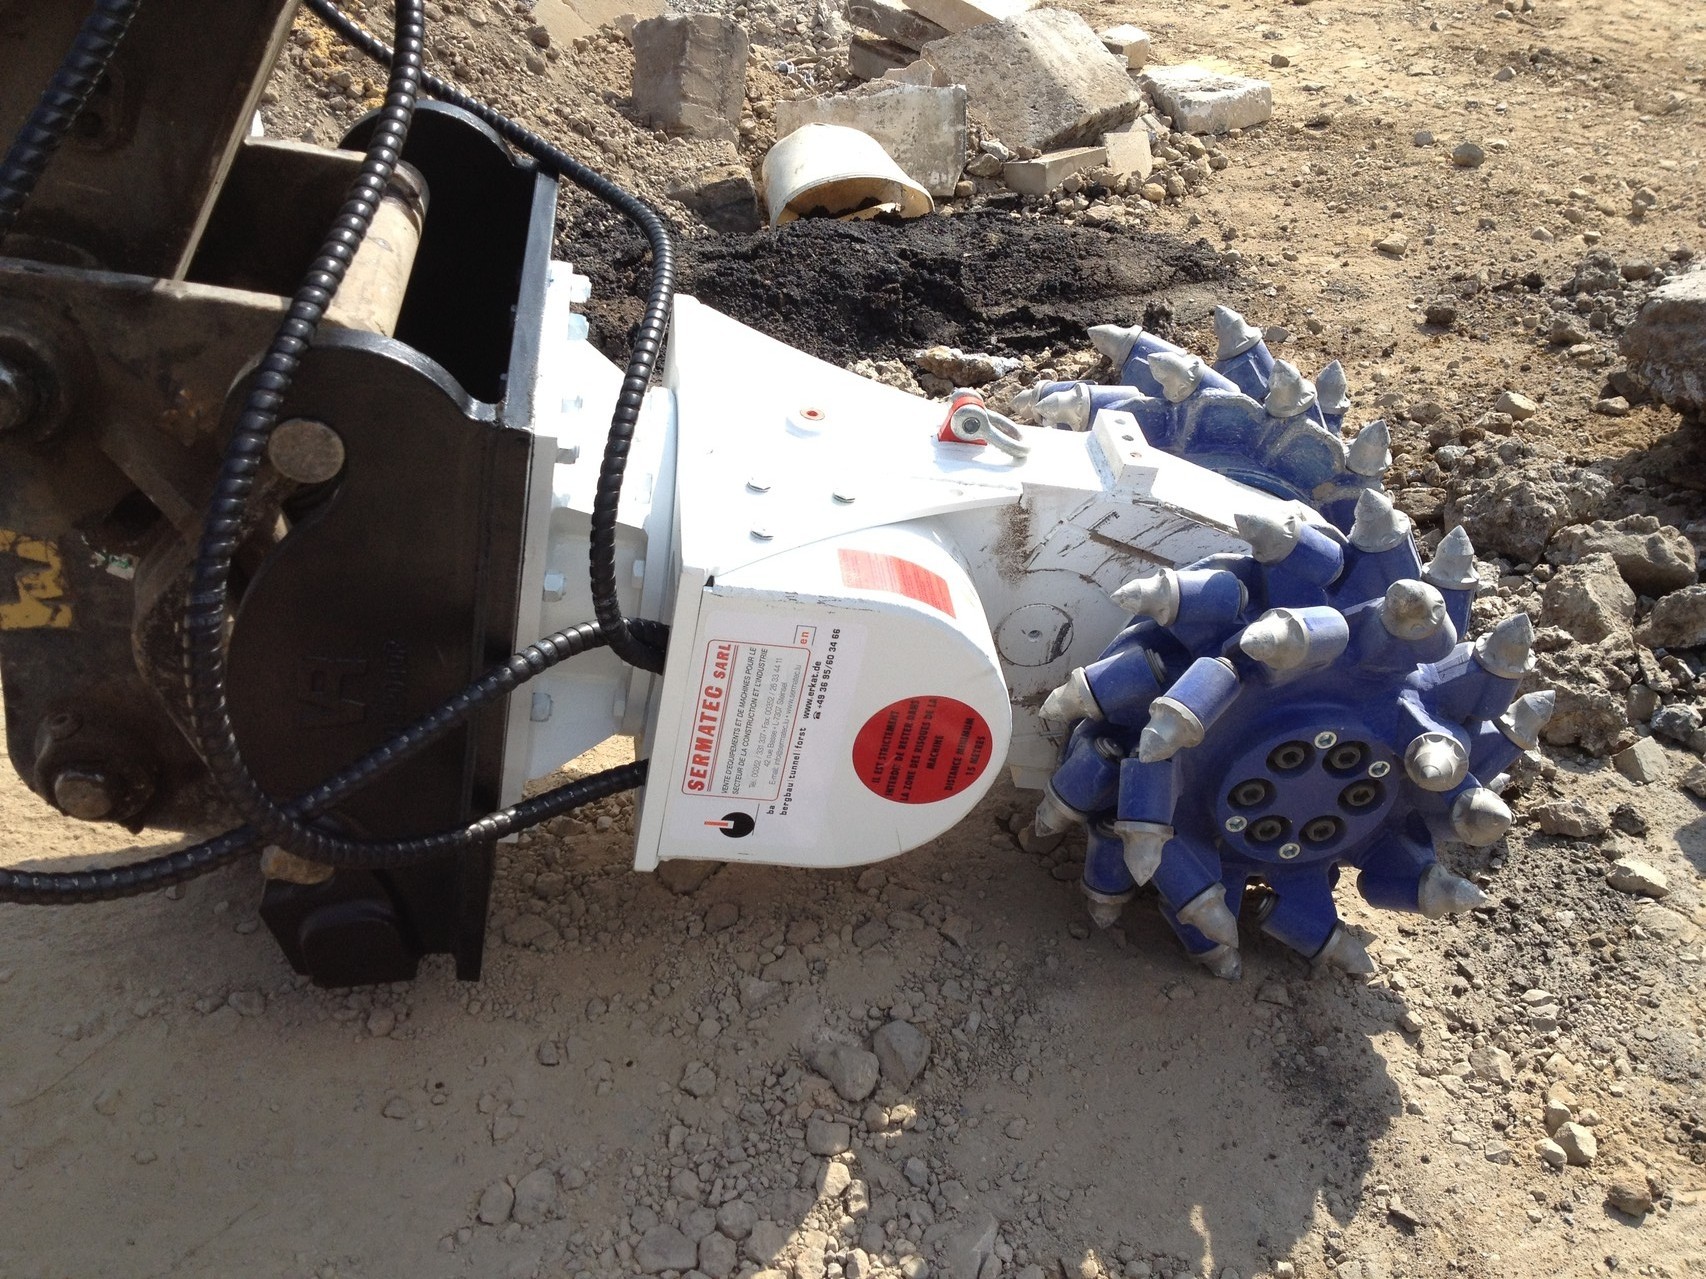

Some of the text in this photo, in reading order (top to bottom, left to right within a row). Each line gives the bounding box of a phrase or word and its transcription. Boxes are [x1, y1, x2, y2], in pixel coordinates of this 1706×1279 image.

[771, 673, 779, 683] 33
[773, 664, 781, 674] 44
[816, 628, 840, 709] +49 36 95/60 34 66
[802, 661, 821, 719] www.erkat.de
[687, 643, 731, 792] SERMATEC SARL
[722, 647, 756, 793] VENTE D'EQUIPEMENTS ET DE MACHINES POUR LE
[732, 648, 768, 795] SECTEUR DE LA CONSTRUCTION ET L'INDUSTRIE
[767, 730, 777, 748] Basse
[872, 710, 900, 784] IL EST STRICTEMENT
[898, 722, 913, 750] RESTER
[900, 698, 937, 801] LA ZONE DES RISQUES DE LA
[926, 734, 944, 770] MACHINE
[764, 759, 771, 767] 42
[895, 751, 905, 762] DE
[944, 756, 962, 791] DISTANCE
[966, 735, 985, 776] 15 METRES
[766, 805, 775, 815] ba
